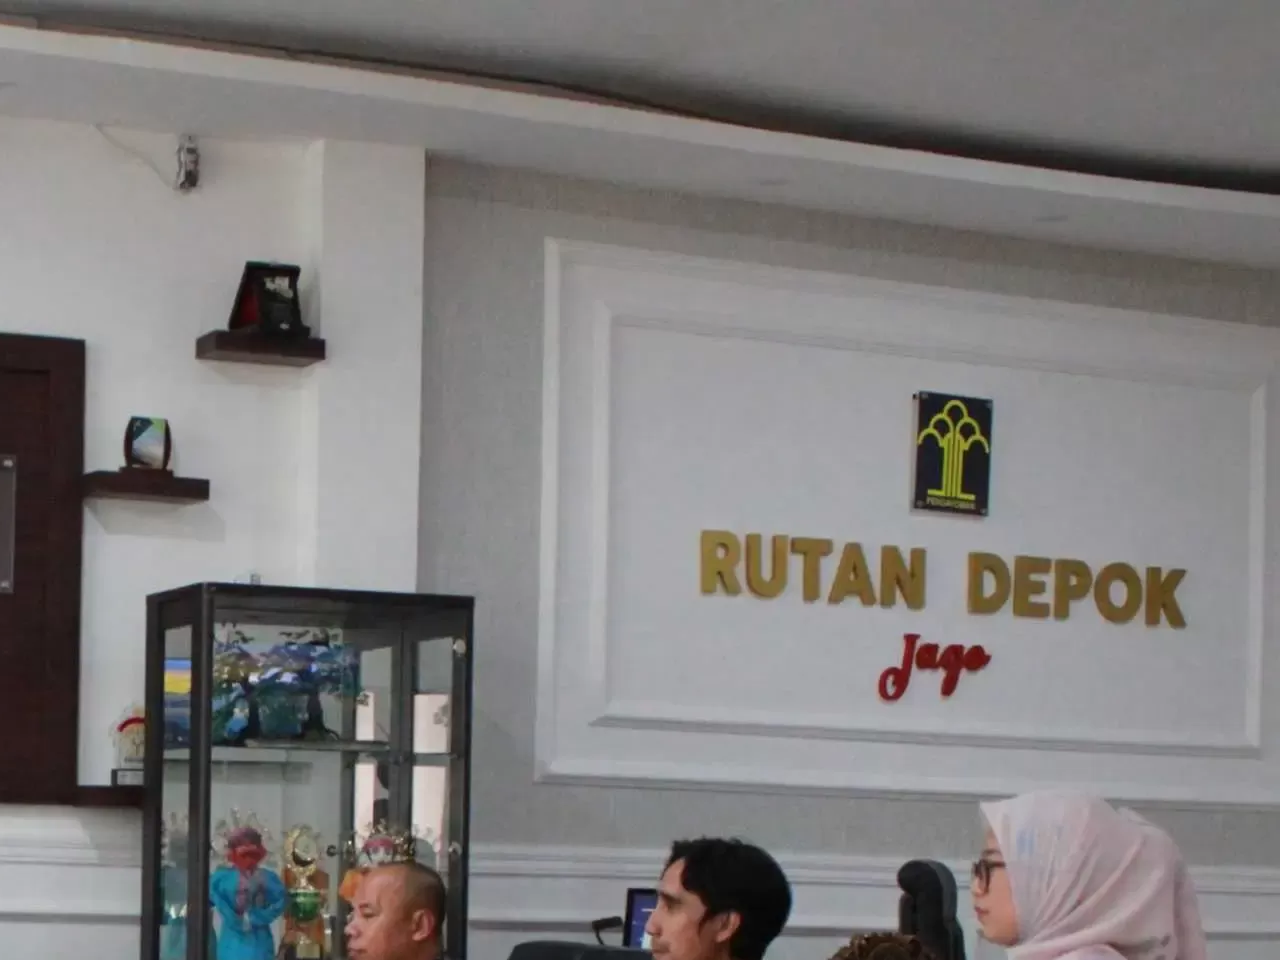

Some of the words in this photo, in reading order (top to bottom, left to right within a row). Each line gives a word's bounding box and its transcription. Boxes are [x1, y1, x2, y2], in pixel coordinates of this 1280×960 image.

[700, 529, 927, 611] RUTAN
[967, 551, 1187, 629] DEPOK
[878, 633, 991, 701] Jago
